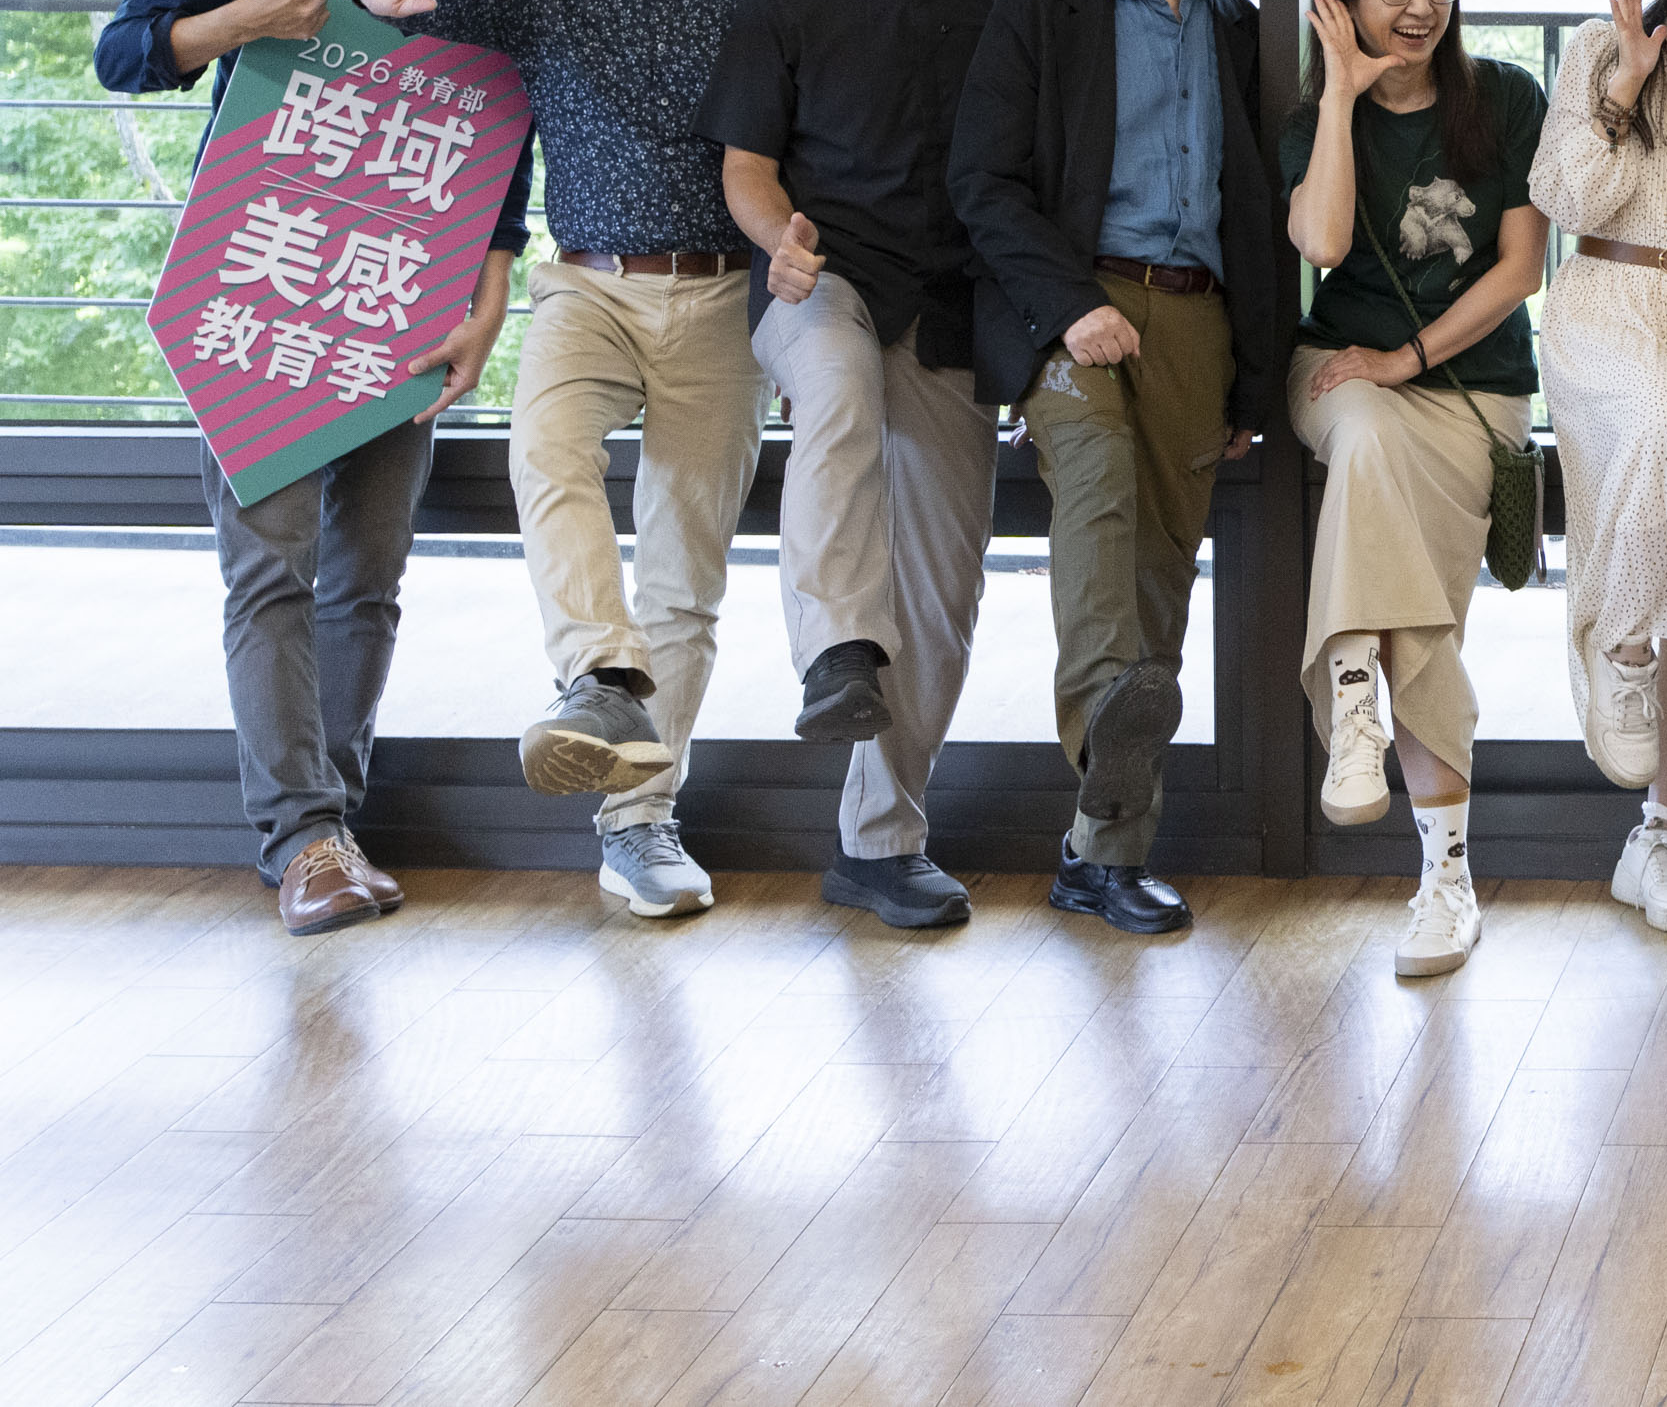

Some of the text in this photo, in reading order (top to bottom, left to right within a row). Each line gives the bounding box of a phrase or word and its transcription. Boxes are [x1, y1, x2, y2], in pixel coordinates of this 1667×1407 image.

[297, 36, 487, 114] 2026 教育部
[262, 68, 477, 213] 跨域
[218, 195, 432, 332] 美感
[191, 296, 397, 404] 教育季
